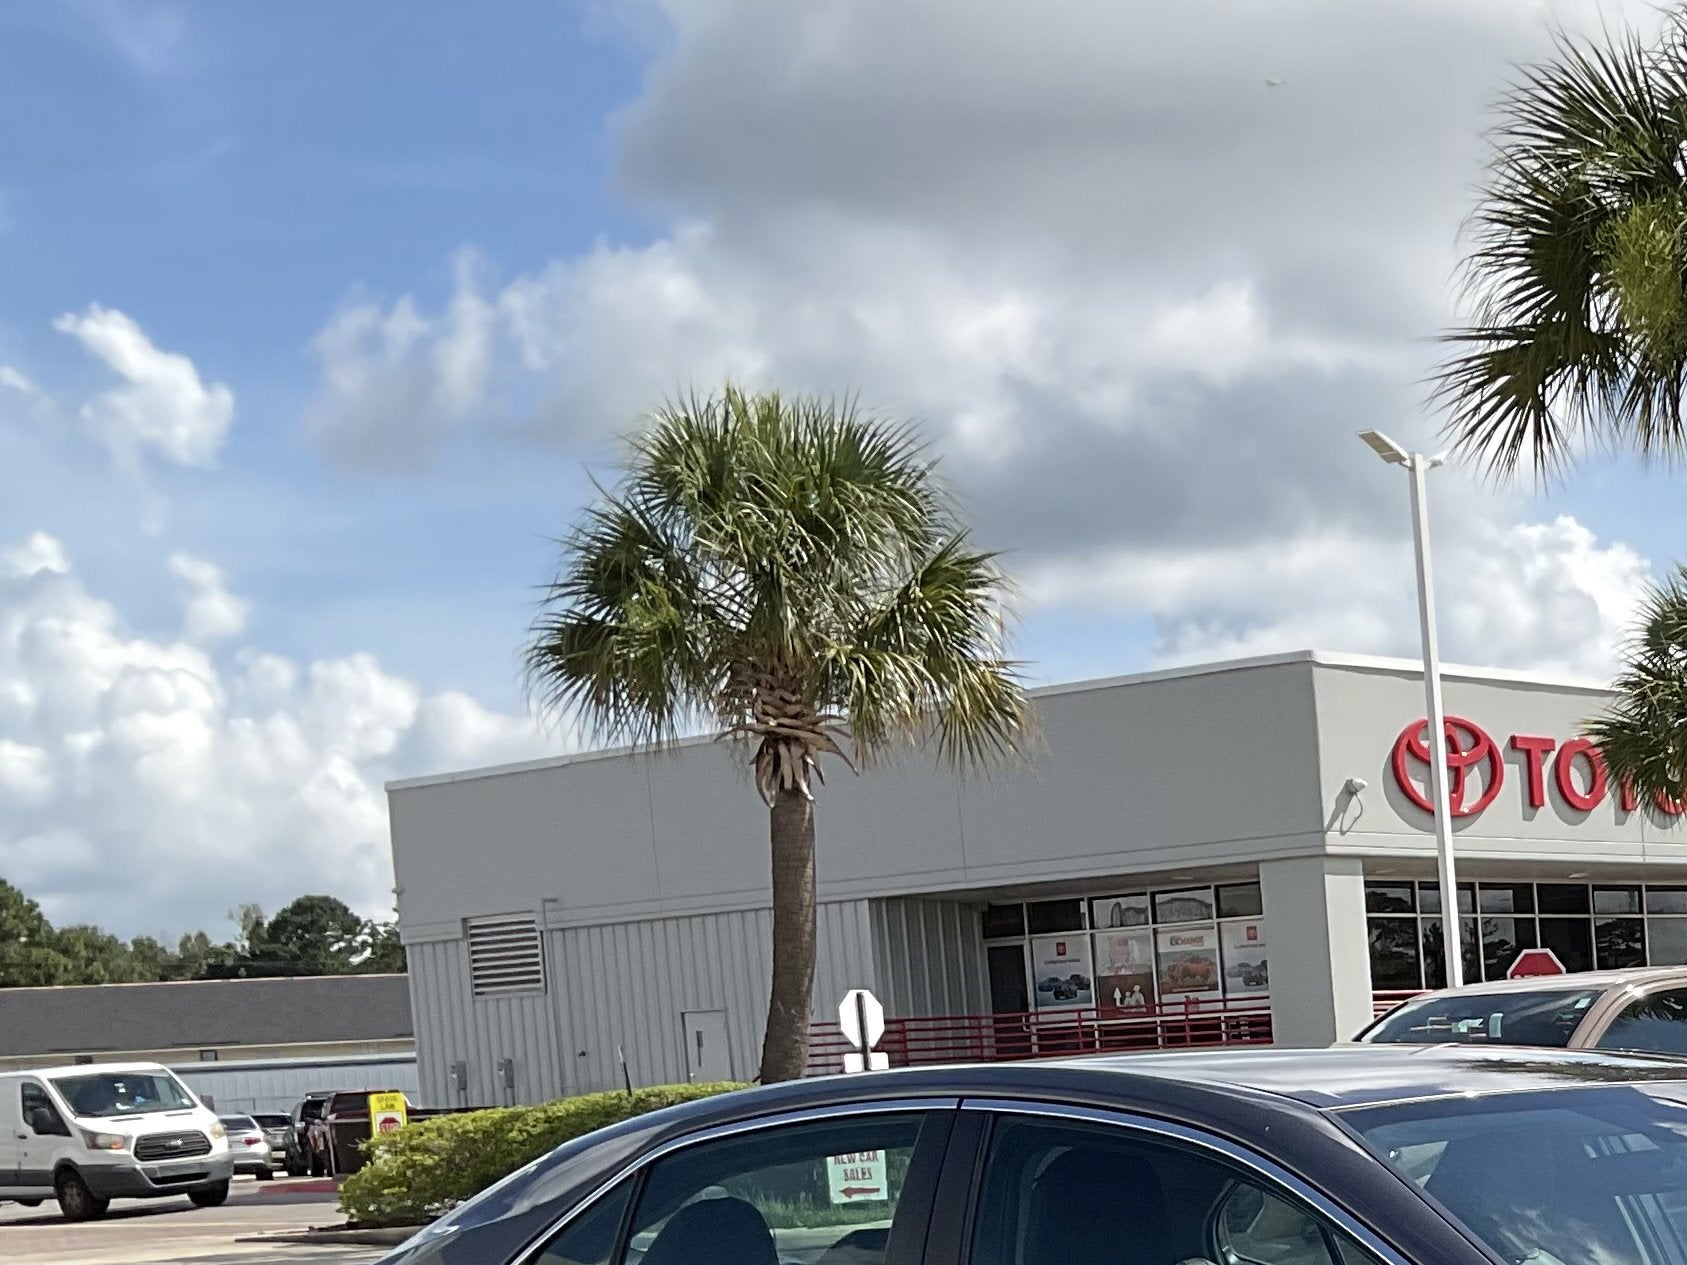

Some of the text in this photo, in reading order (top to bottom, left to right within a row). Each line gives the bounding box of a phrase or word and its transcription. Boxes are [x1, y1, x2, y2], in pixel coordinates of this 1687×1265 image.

[834, 1151, 878, 1165] NEW CAR
[843, 1168, 872, 1181] SALES
